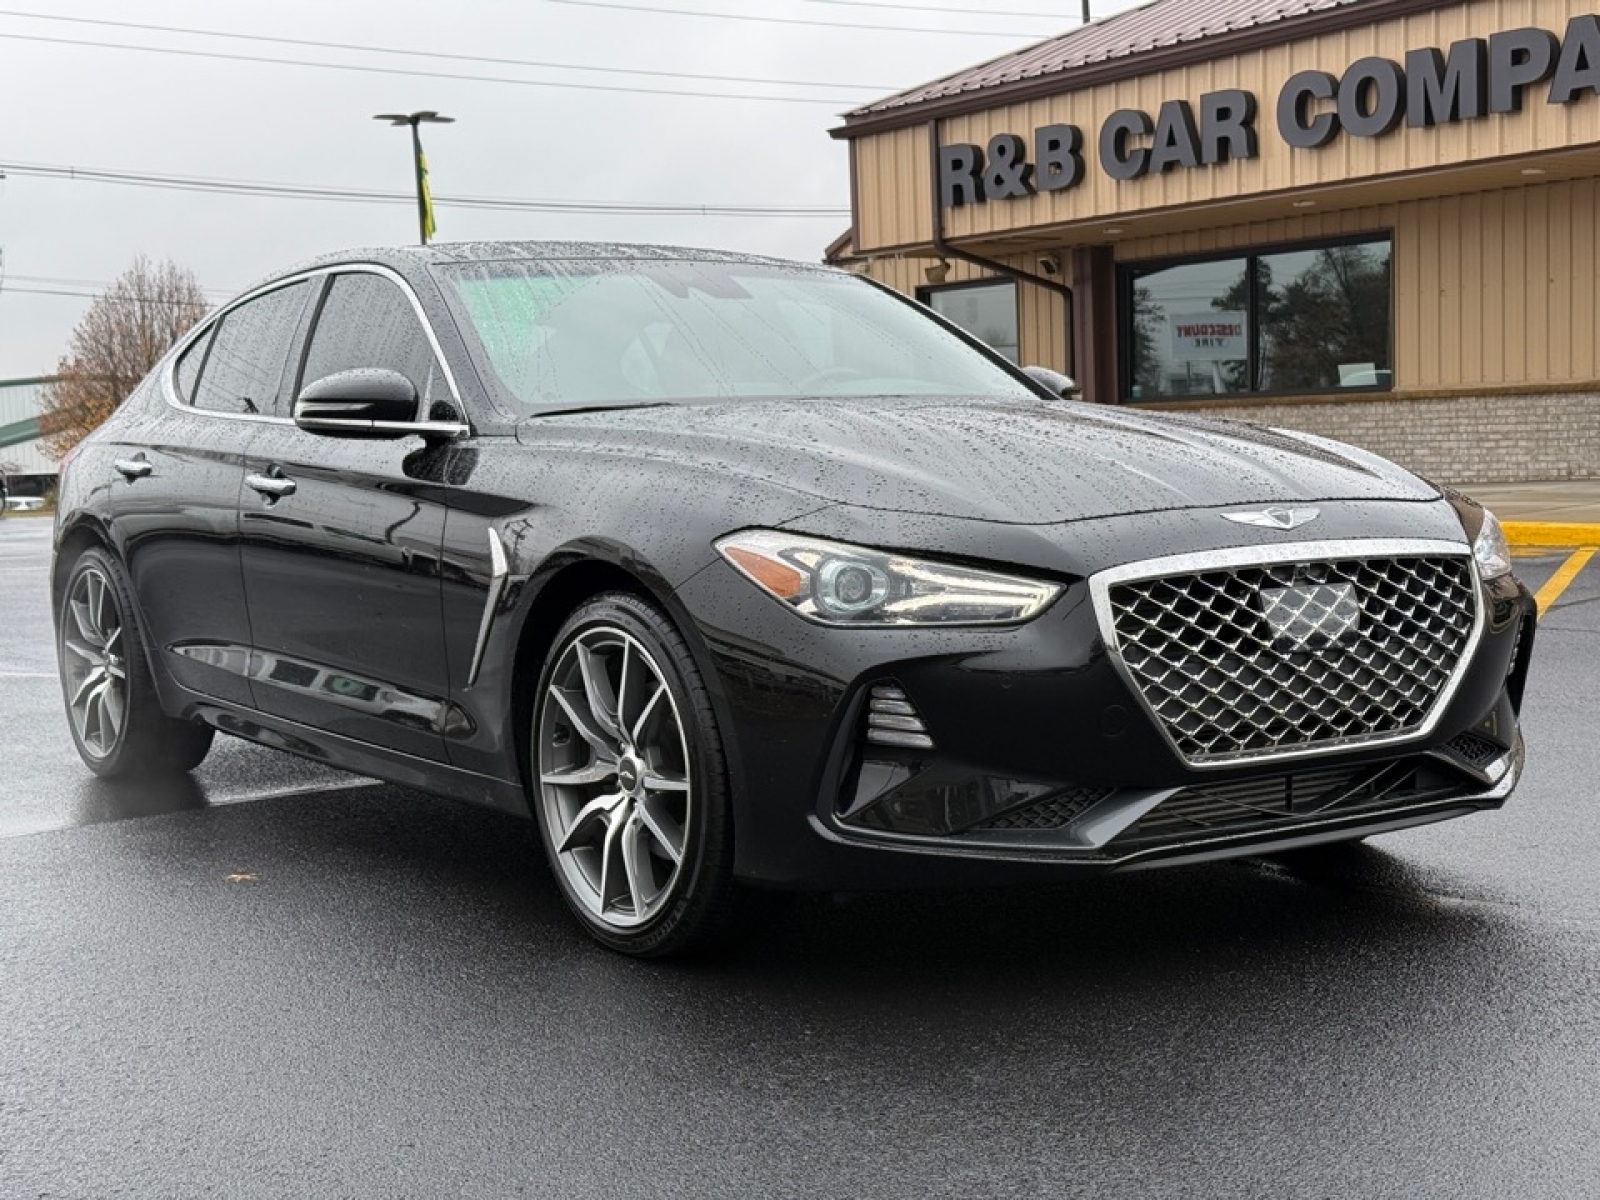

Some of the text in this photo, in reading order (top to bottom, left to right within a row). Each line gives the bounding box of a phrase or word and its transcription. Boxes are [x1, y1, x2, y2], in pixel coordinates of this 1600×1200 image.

[939, 13, 1600, 207] R&B CAR COMPA
